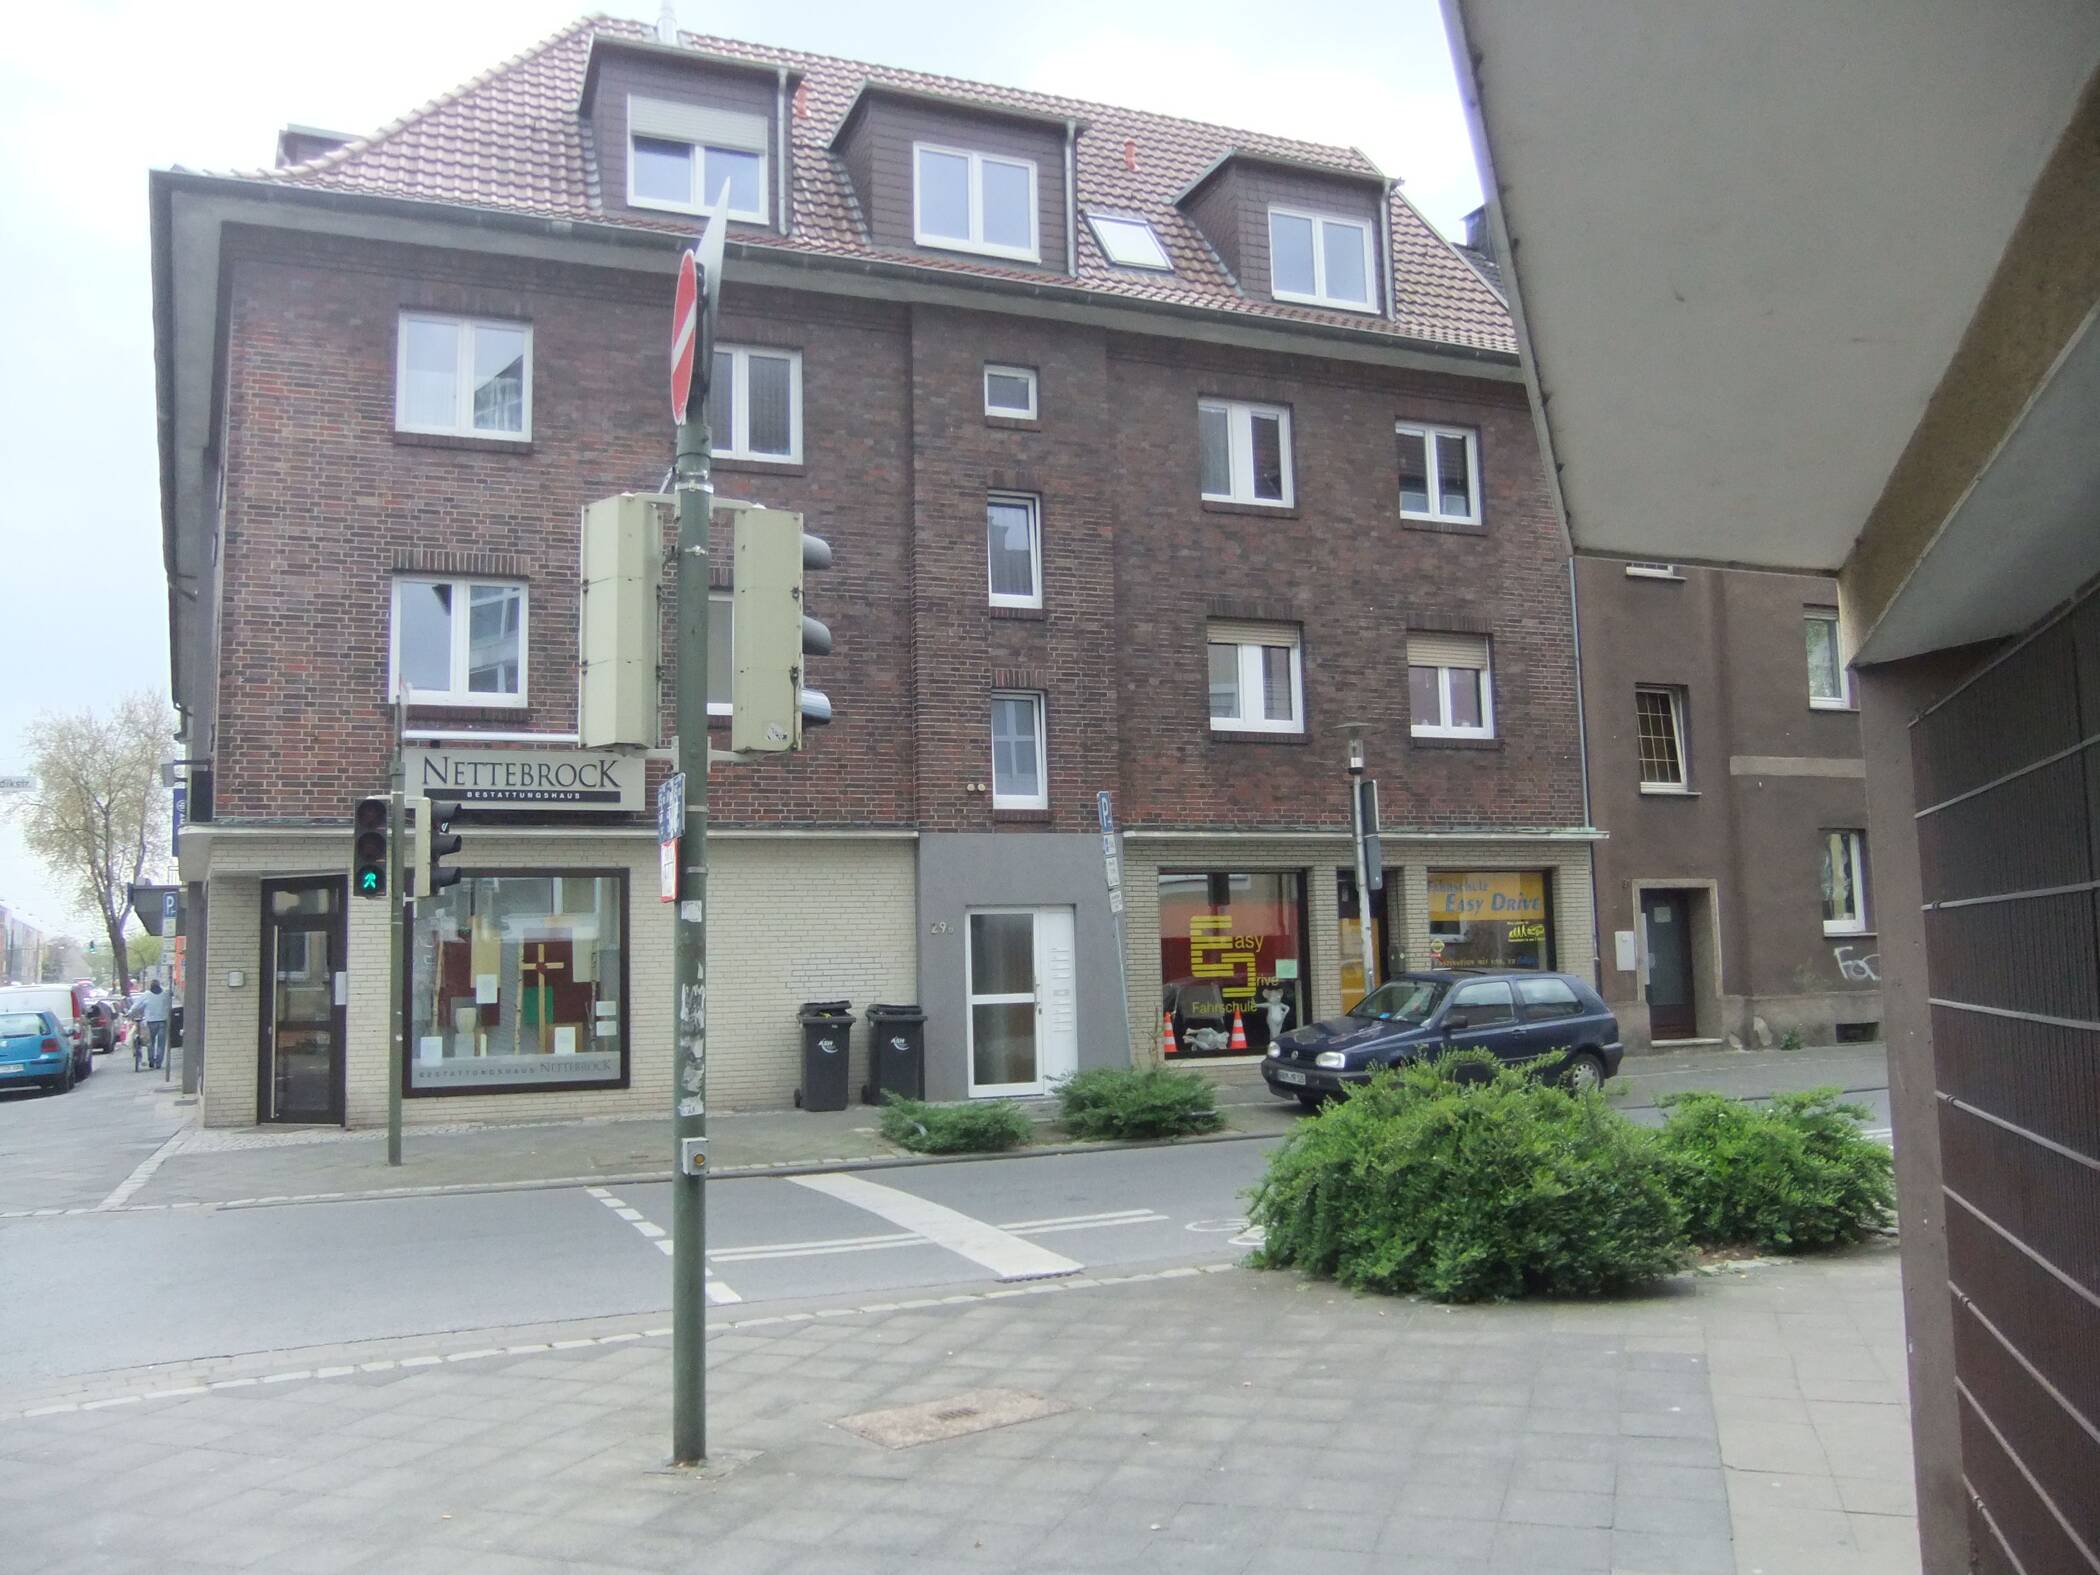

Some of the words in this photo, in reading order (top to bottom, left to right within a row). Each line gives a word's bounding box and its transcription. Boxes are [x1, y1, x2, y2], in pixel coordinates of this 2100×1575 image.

[422, 756, 621, 788] NETTEBROCK
[466, 791, 581, 800] BESTATTUNGSHAUS
[1192, 999, 1258, 1014] Fahrschule
